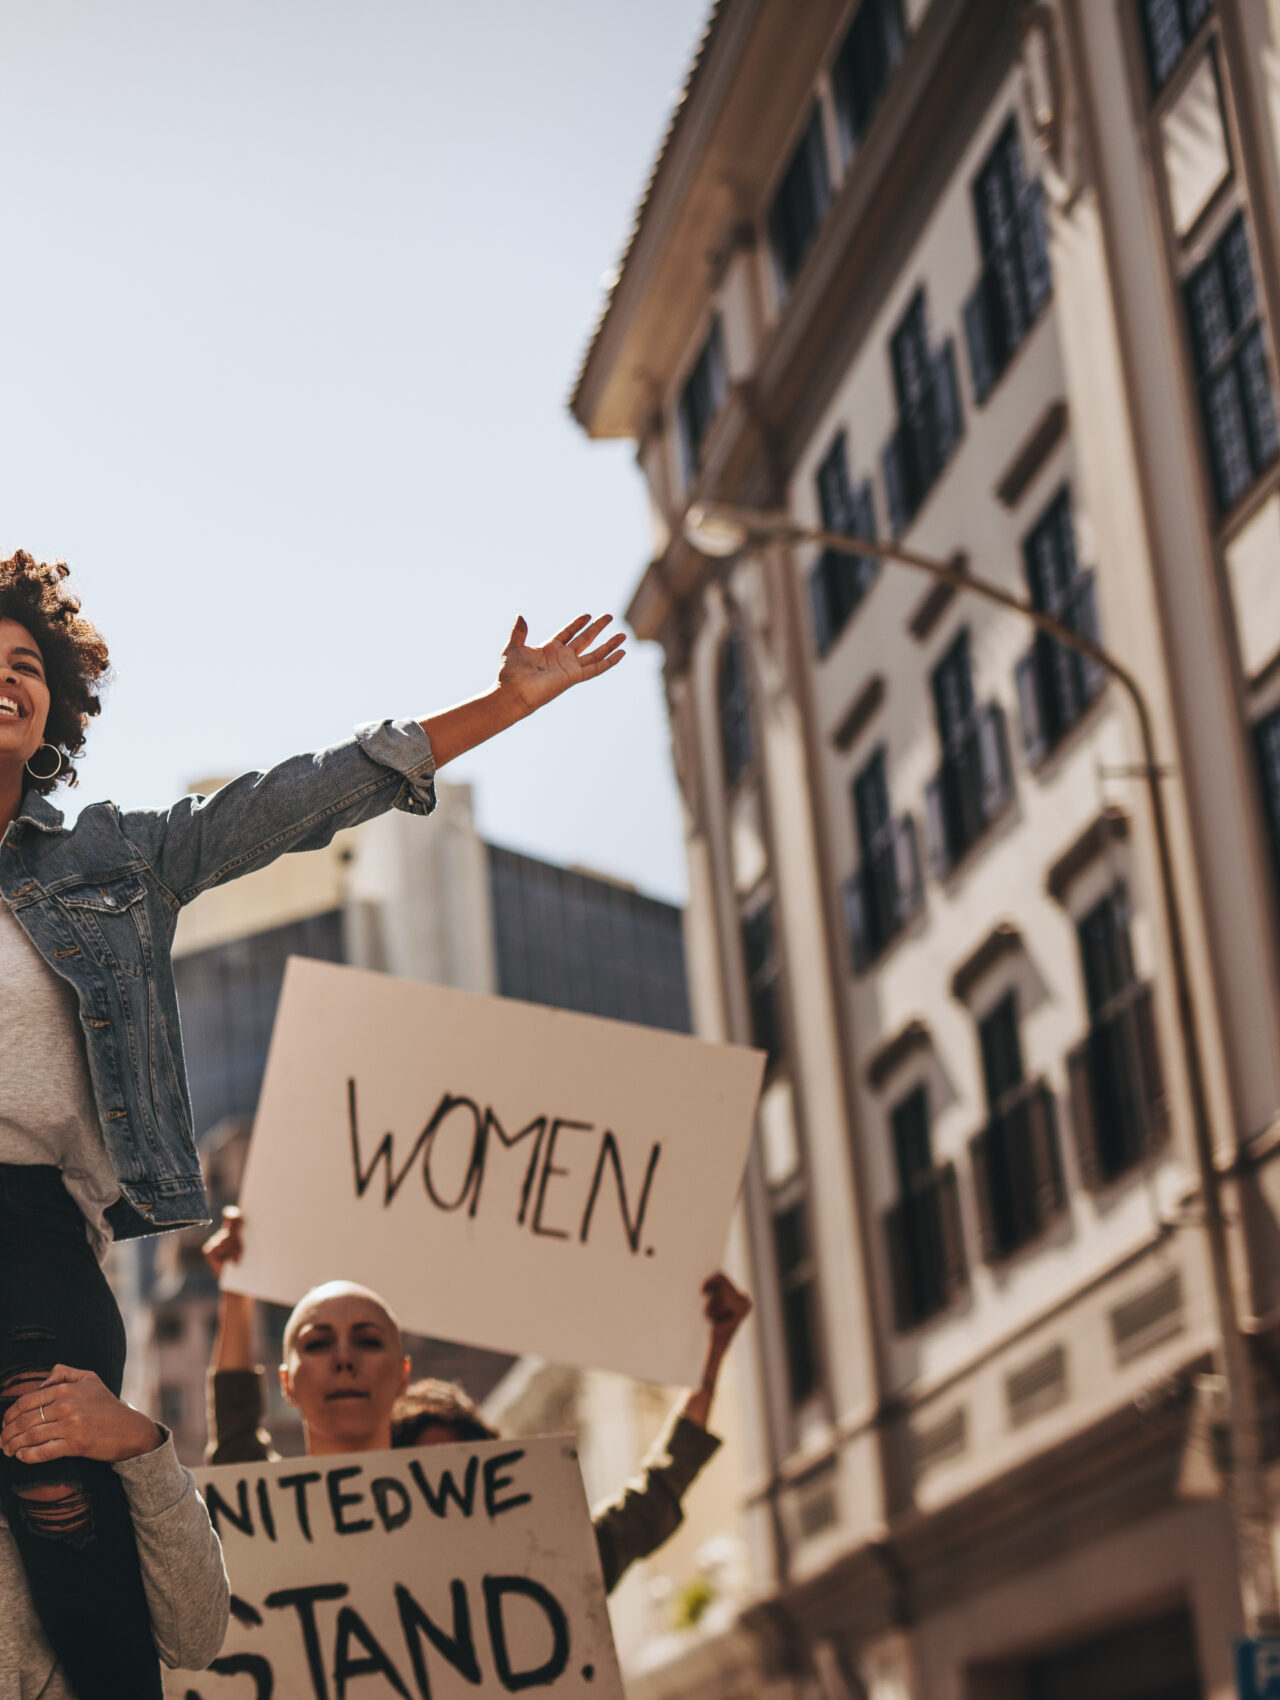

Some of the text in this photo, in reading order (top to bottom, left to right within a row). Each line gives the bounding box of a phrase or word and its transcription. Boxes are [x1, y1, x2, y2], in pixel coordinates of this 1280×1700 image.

[346, 1076, 662, 1257] WOMEN.
[202, 1448, 533, 1543] NITED WE
